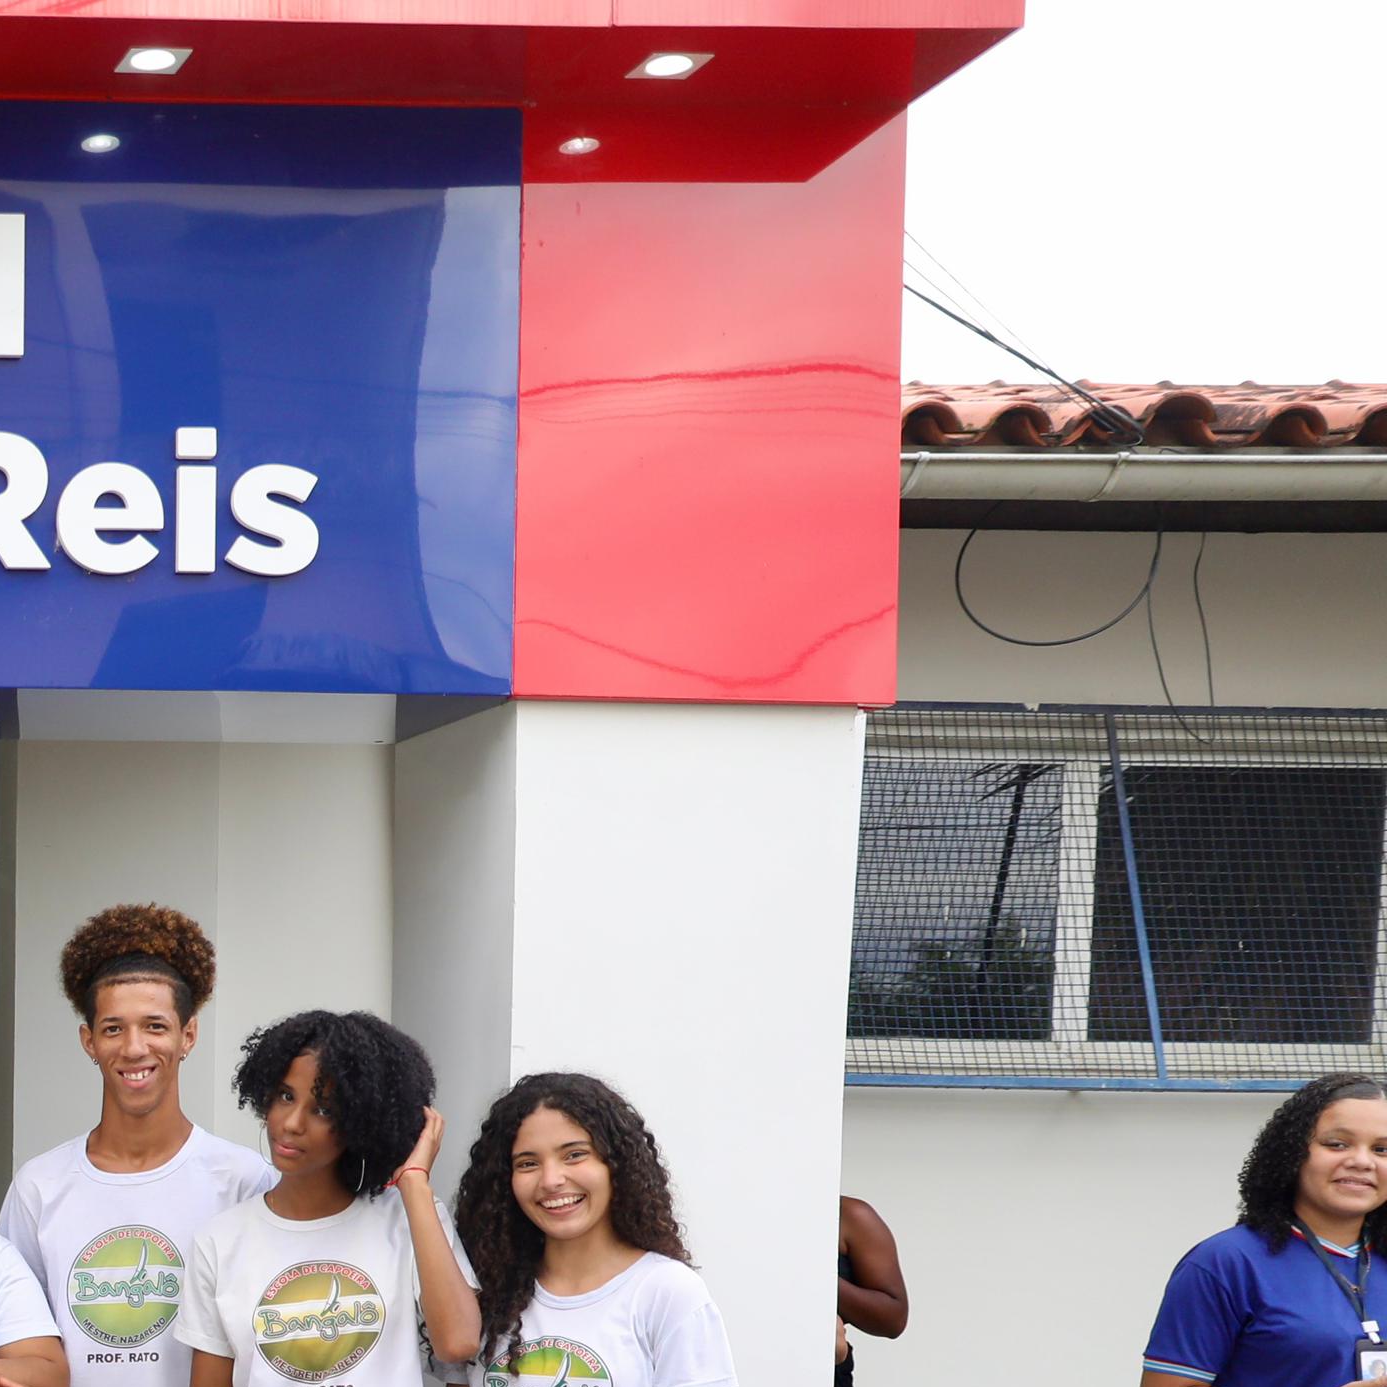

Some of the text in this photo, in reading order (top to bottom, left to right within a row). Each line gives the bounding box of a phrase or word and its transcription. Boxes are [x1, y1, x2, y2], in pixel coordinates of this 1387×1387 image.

[82, 1230, 177, 1263] ESCOLA DE CAPOEIRA
[73, 1271, 180, 1309] Bangalô
[265, 1263, 371, 1300] ESCOLA DE CAPOEIRA
[82, 1316, 167, 1344] MESTRE NAZARENO
[258, 1300, 380, 1341] Bangalô
[87, 1352, 160, 1364] PROF. RATO
[272, 1356, 312, 1380] MESTRE
[555, 1340, 601, 1374] CAPOEIRA
